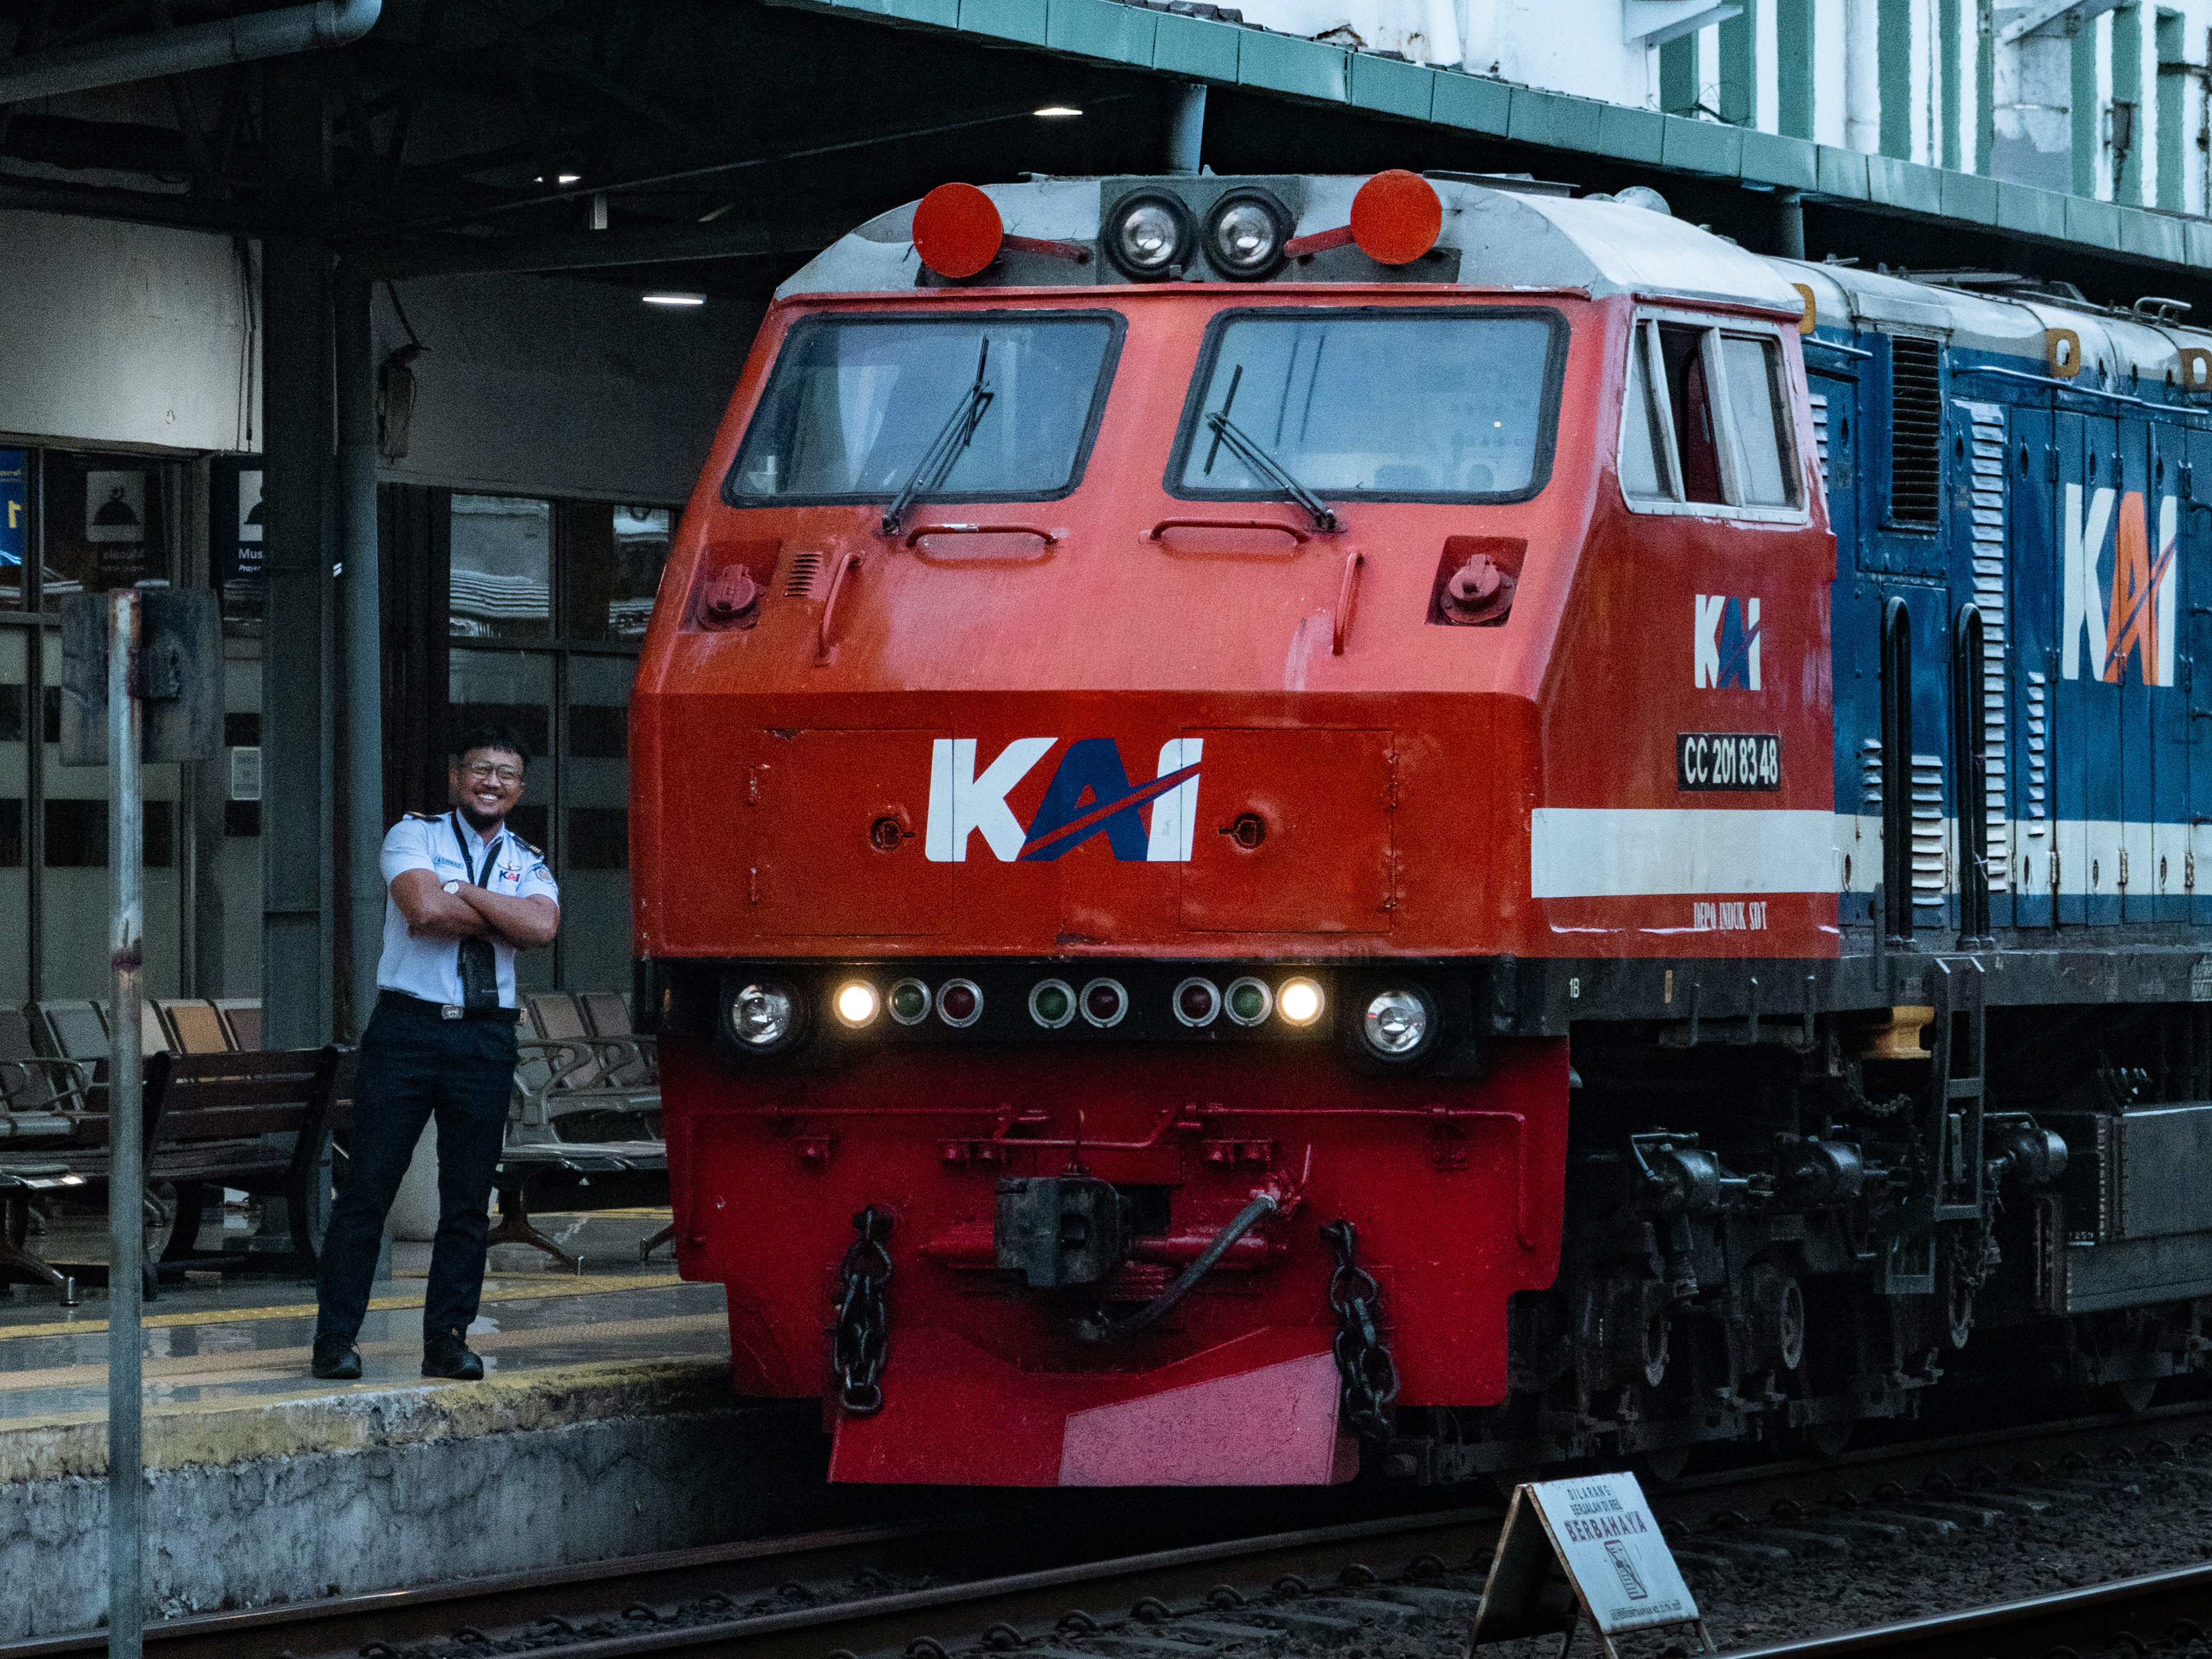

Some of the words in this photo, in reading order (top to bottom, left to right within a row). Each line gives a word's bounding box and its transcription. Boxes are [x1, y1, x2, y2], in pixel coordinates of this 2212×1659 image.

[2062, 483, 2178, 687] KAI
[1694, 594, 1761, 690] KAI
[1684, 737, 1708, 784] CC
[1713, 737, 1737, 785] 201
[925, 737, 1204, 862] KAI
[1693, 902, 1717, 930] DEPO
[1719, 902, 1747, 930] INDUK
[1749, 901, 1768, 930] SDT
[1567, 1485, 1611, 1500] DILARANG
[1570, 1501, 1603, 1515] BERJALAN
[1601, 1500, 1611, 1511] DI
[1608, 1499, 1623, 1510] REL
[1565, 1513, 1648, 1541] BERBAHAYA
